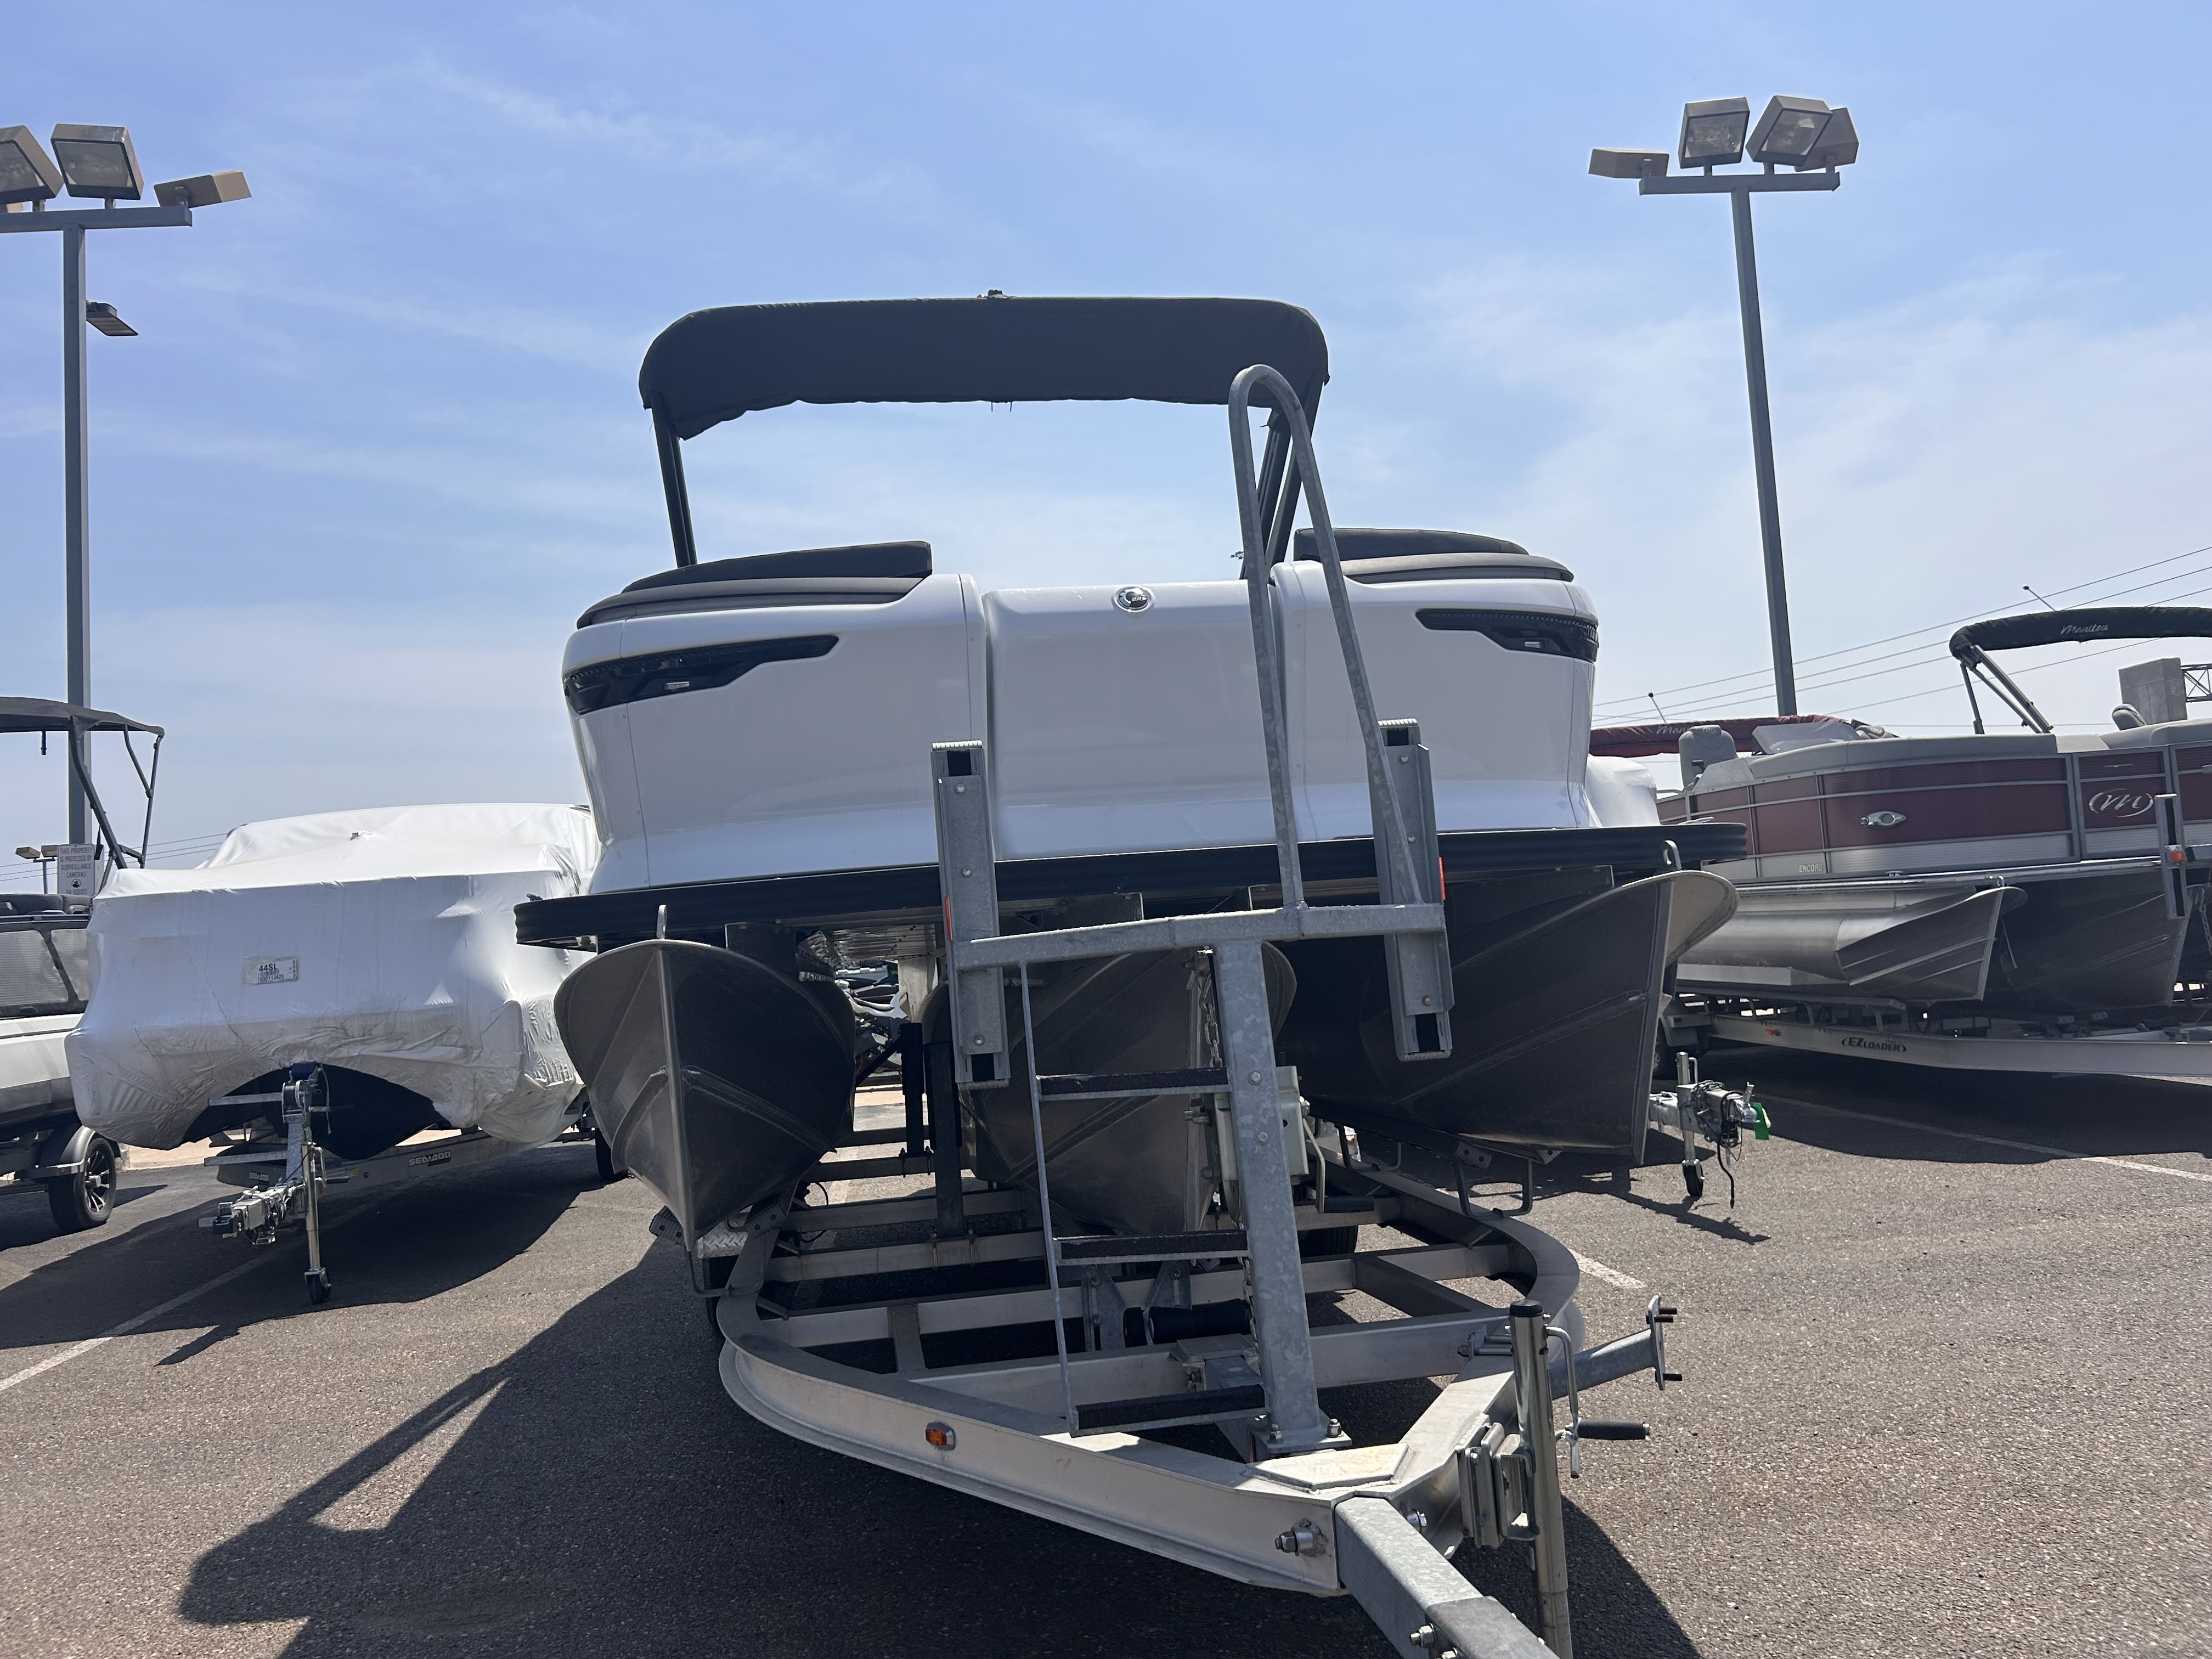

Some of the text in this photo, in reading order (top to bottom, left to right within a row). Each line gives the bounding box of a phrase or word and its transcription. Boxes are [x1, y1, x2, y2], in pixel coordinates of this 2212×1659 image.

[2060, 624, 2109, 635] Manitou
[1799, 864, 1823, 873] ENCORE
[258, 963, 278, 972] 44SL
